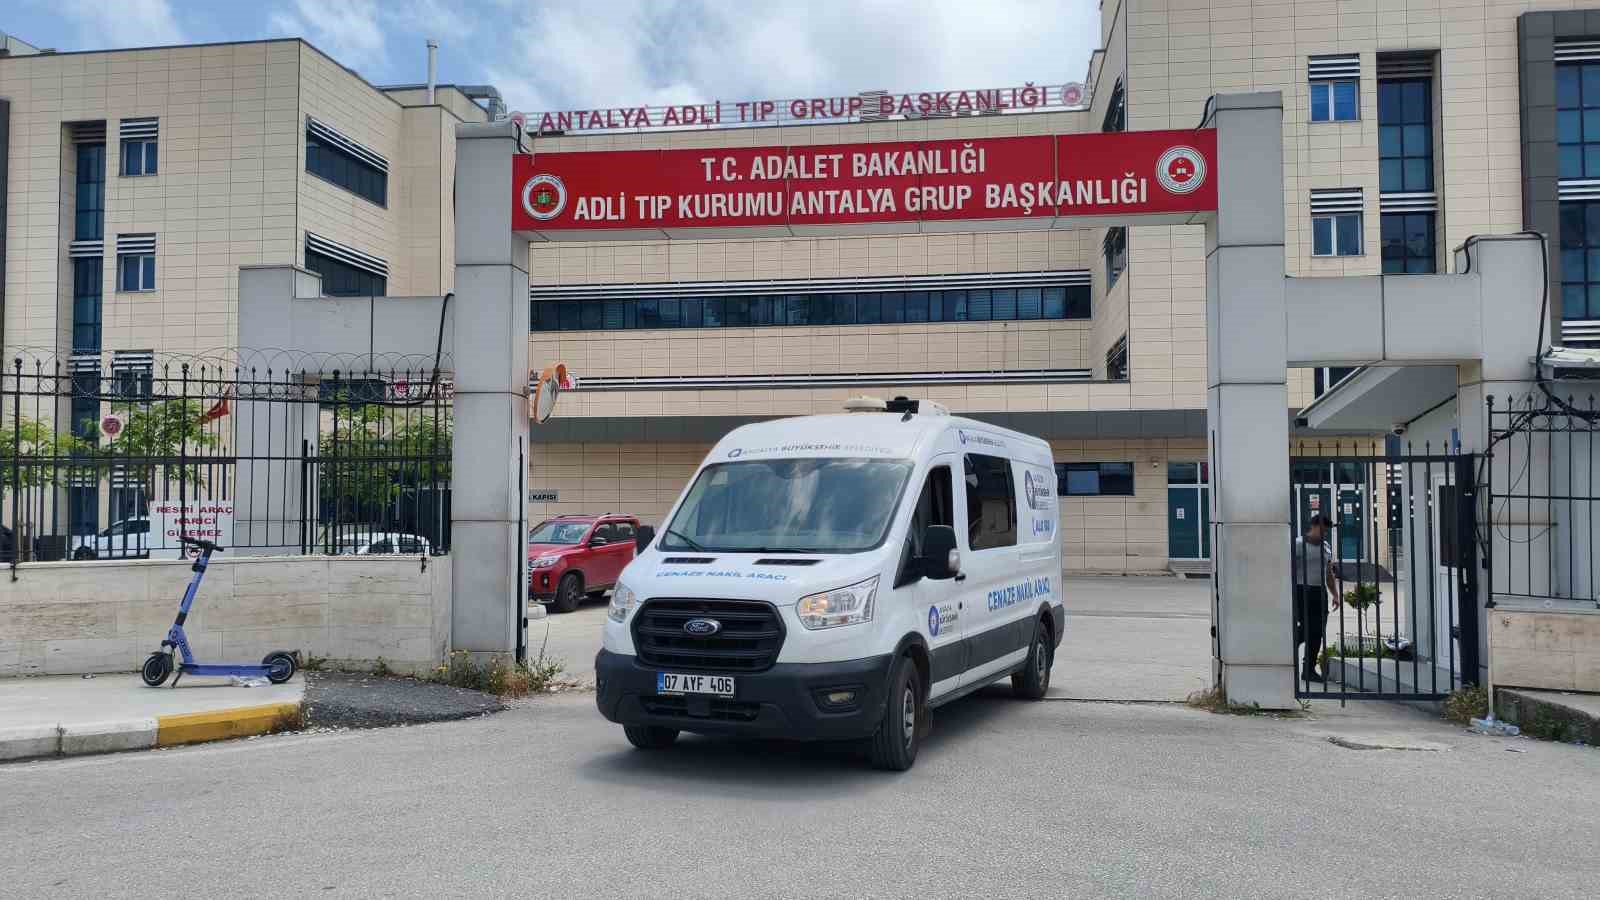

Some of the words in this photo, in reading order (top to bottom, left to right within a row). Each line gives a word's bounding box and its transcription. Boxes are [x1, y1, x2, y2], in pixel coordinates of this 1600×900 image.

[539, 107, 649, 130] ANTALYA
[663, 100, 721, 127] ADLİ
[736, 101, 775, 121] TIP
[790, 96, 862, 118] GRUP
[880, 82, 1048, 119] BAŞKANLIĞI
[701, 156, 743, 182] T.C.
[750, 153, 844, 180] ADALET
[853, 143, 986, 177] BAKANLIĞI
[574, 191, 625, 221] ADLİ
[635, 195, 672, 220] TIP
[678, 191, 783, 218] KURUMU
[790, 187, 897, 216] ANTALYA
[905, 185, 973, 212] GRUP
[985, 172, 1149, 215] BAŞKANLIĞI
[988, 586, 1016, 611] CENAZE
[664, 675, 678, 690] 07
[683, 676, 704, 691] AYF
[711, 677, 732, 693] 406
